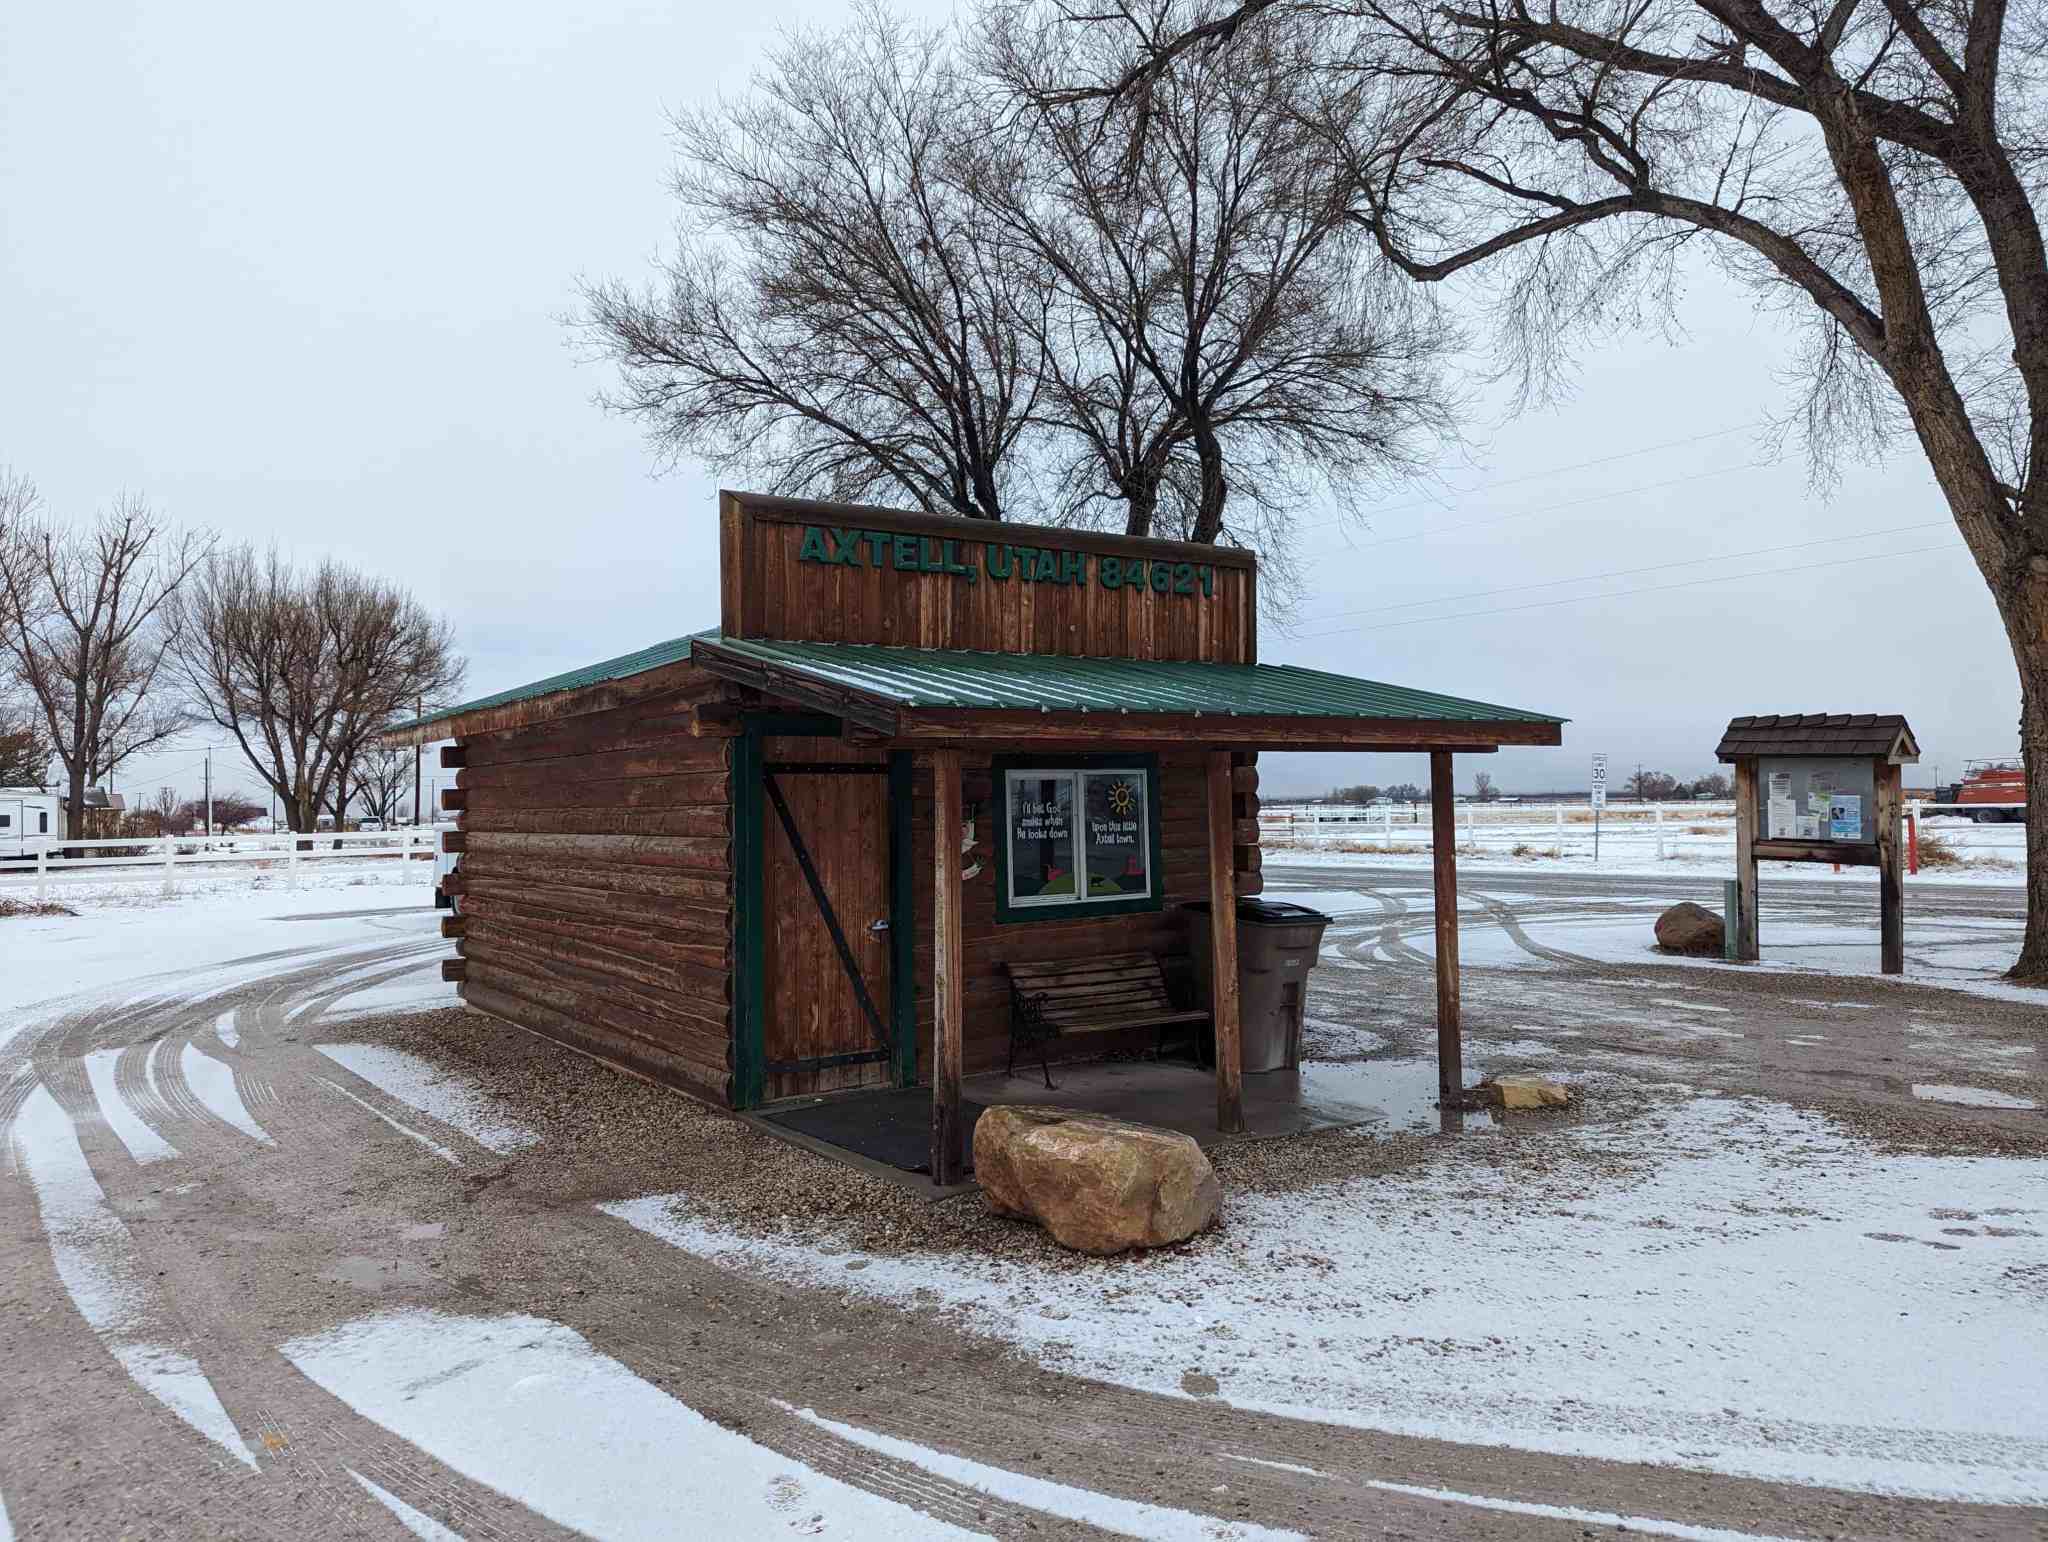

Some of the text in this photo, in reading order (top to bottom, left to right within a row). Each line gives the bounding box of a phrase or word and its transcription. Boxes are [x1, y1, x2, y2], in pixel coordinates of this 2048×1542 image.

[800, 526, 1213, 598] AXTELL, UTAH 84621
[1593, 768, 1605, 779] 30
[1028, 828, 1047, 839] looks
[1049, 826, 1068, 839] down
